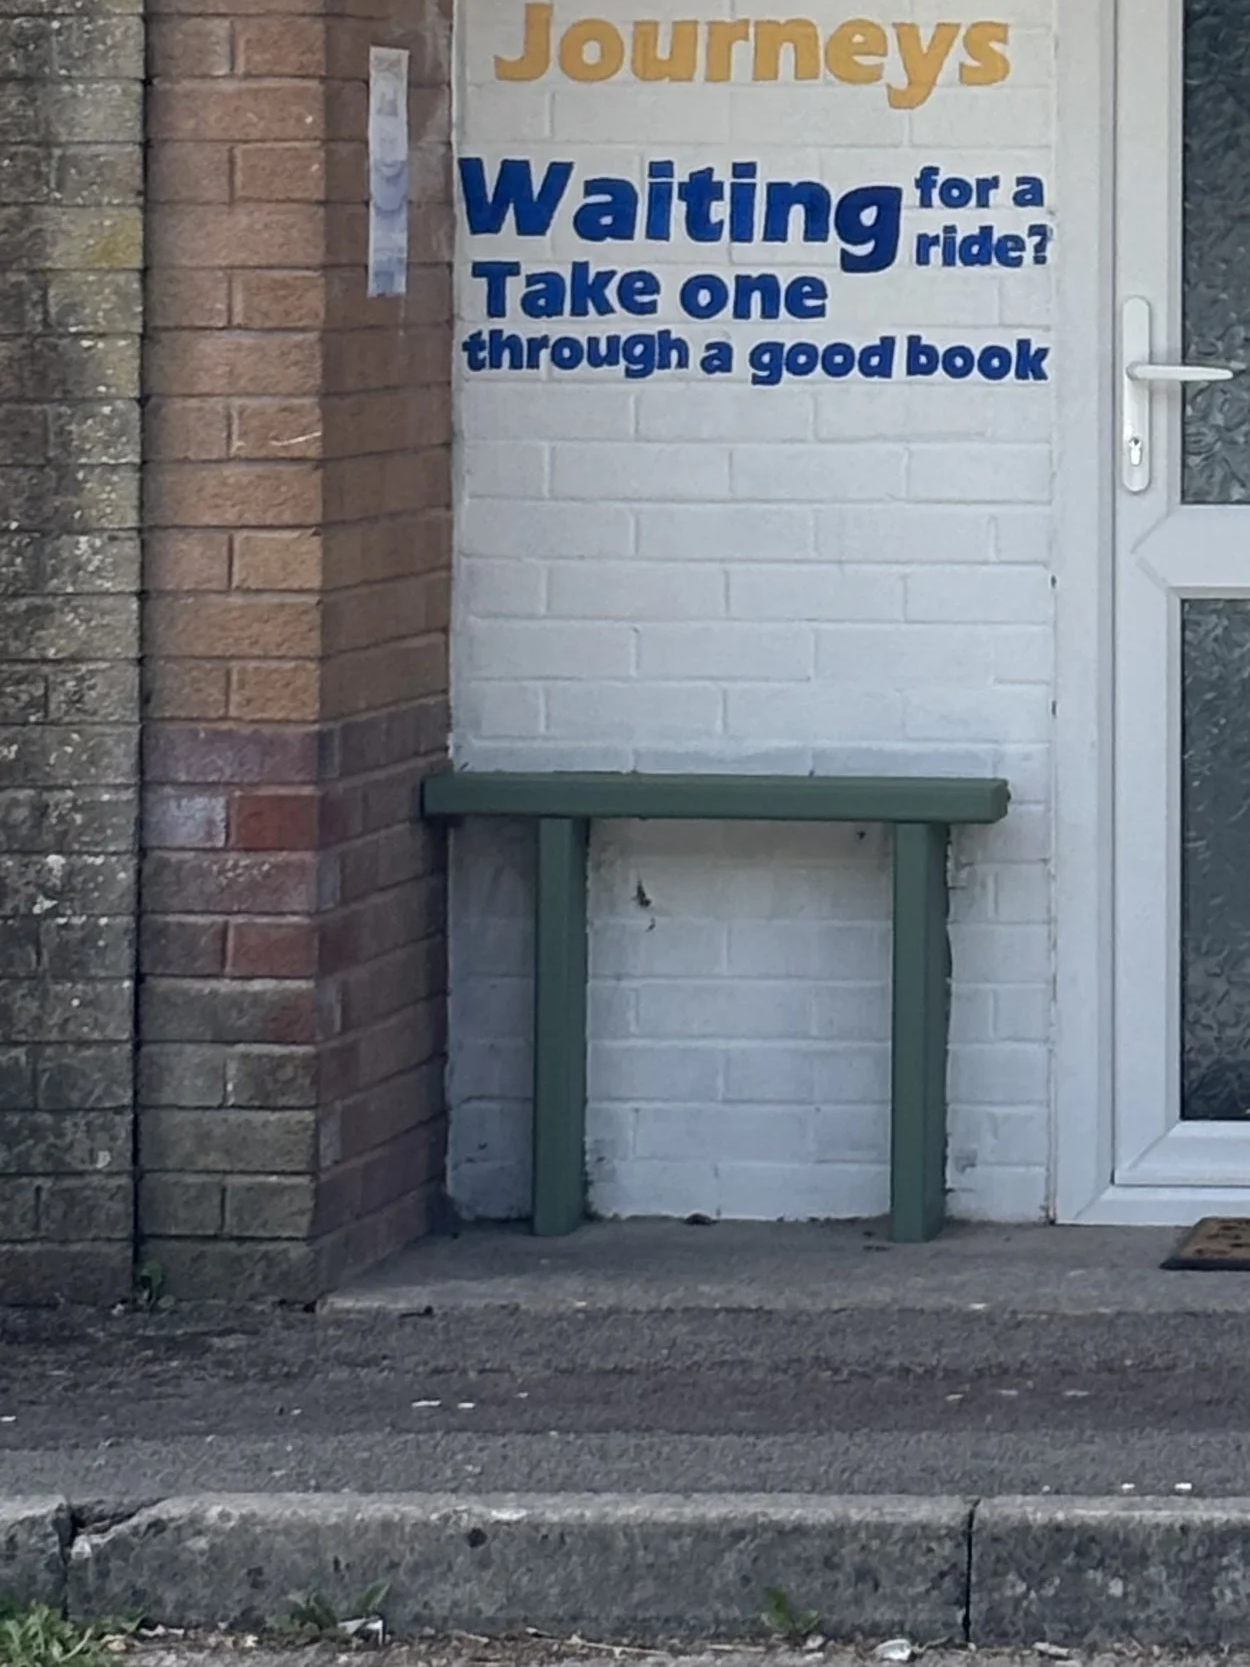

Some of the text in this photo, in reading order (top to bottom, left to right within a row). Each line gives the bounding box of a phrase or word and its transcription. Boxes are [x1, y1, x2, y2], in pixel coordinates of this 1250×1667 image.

[494, 3, 1010, 110] Journeys
[458, 157, 902, 273] Waiting
[915, 166, 1044, 209] for a
[915, 225, 1049, 267] ride?
[472, 261, 829, 320] Take one
[462, 330, 1048, 386] through a good book
